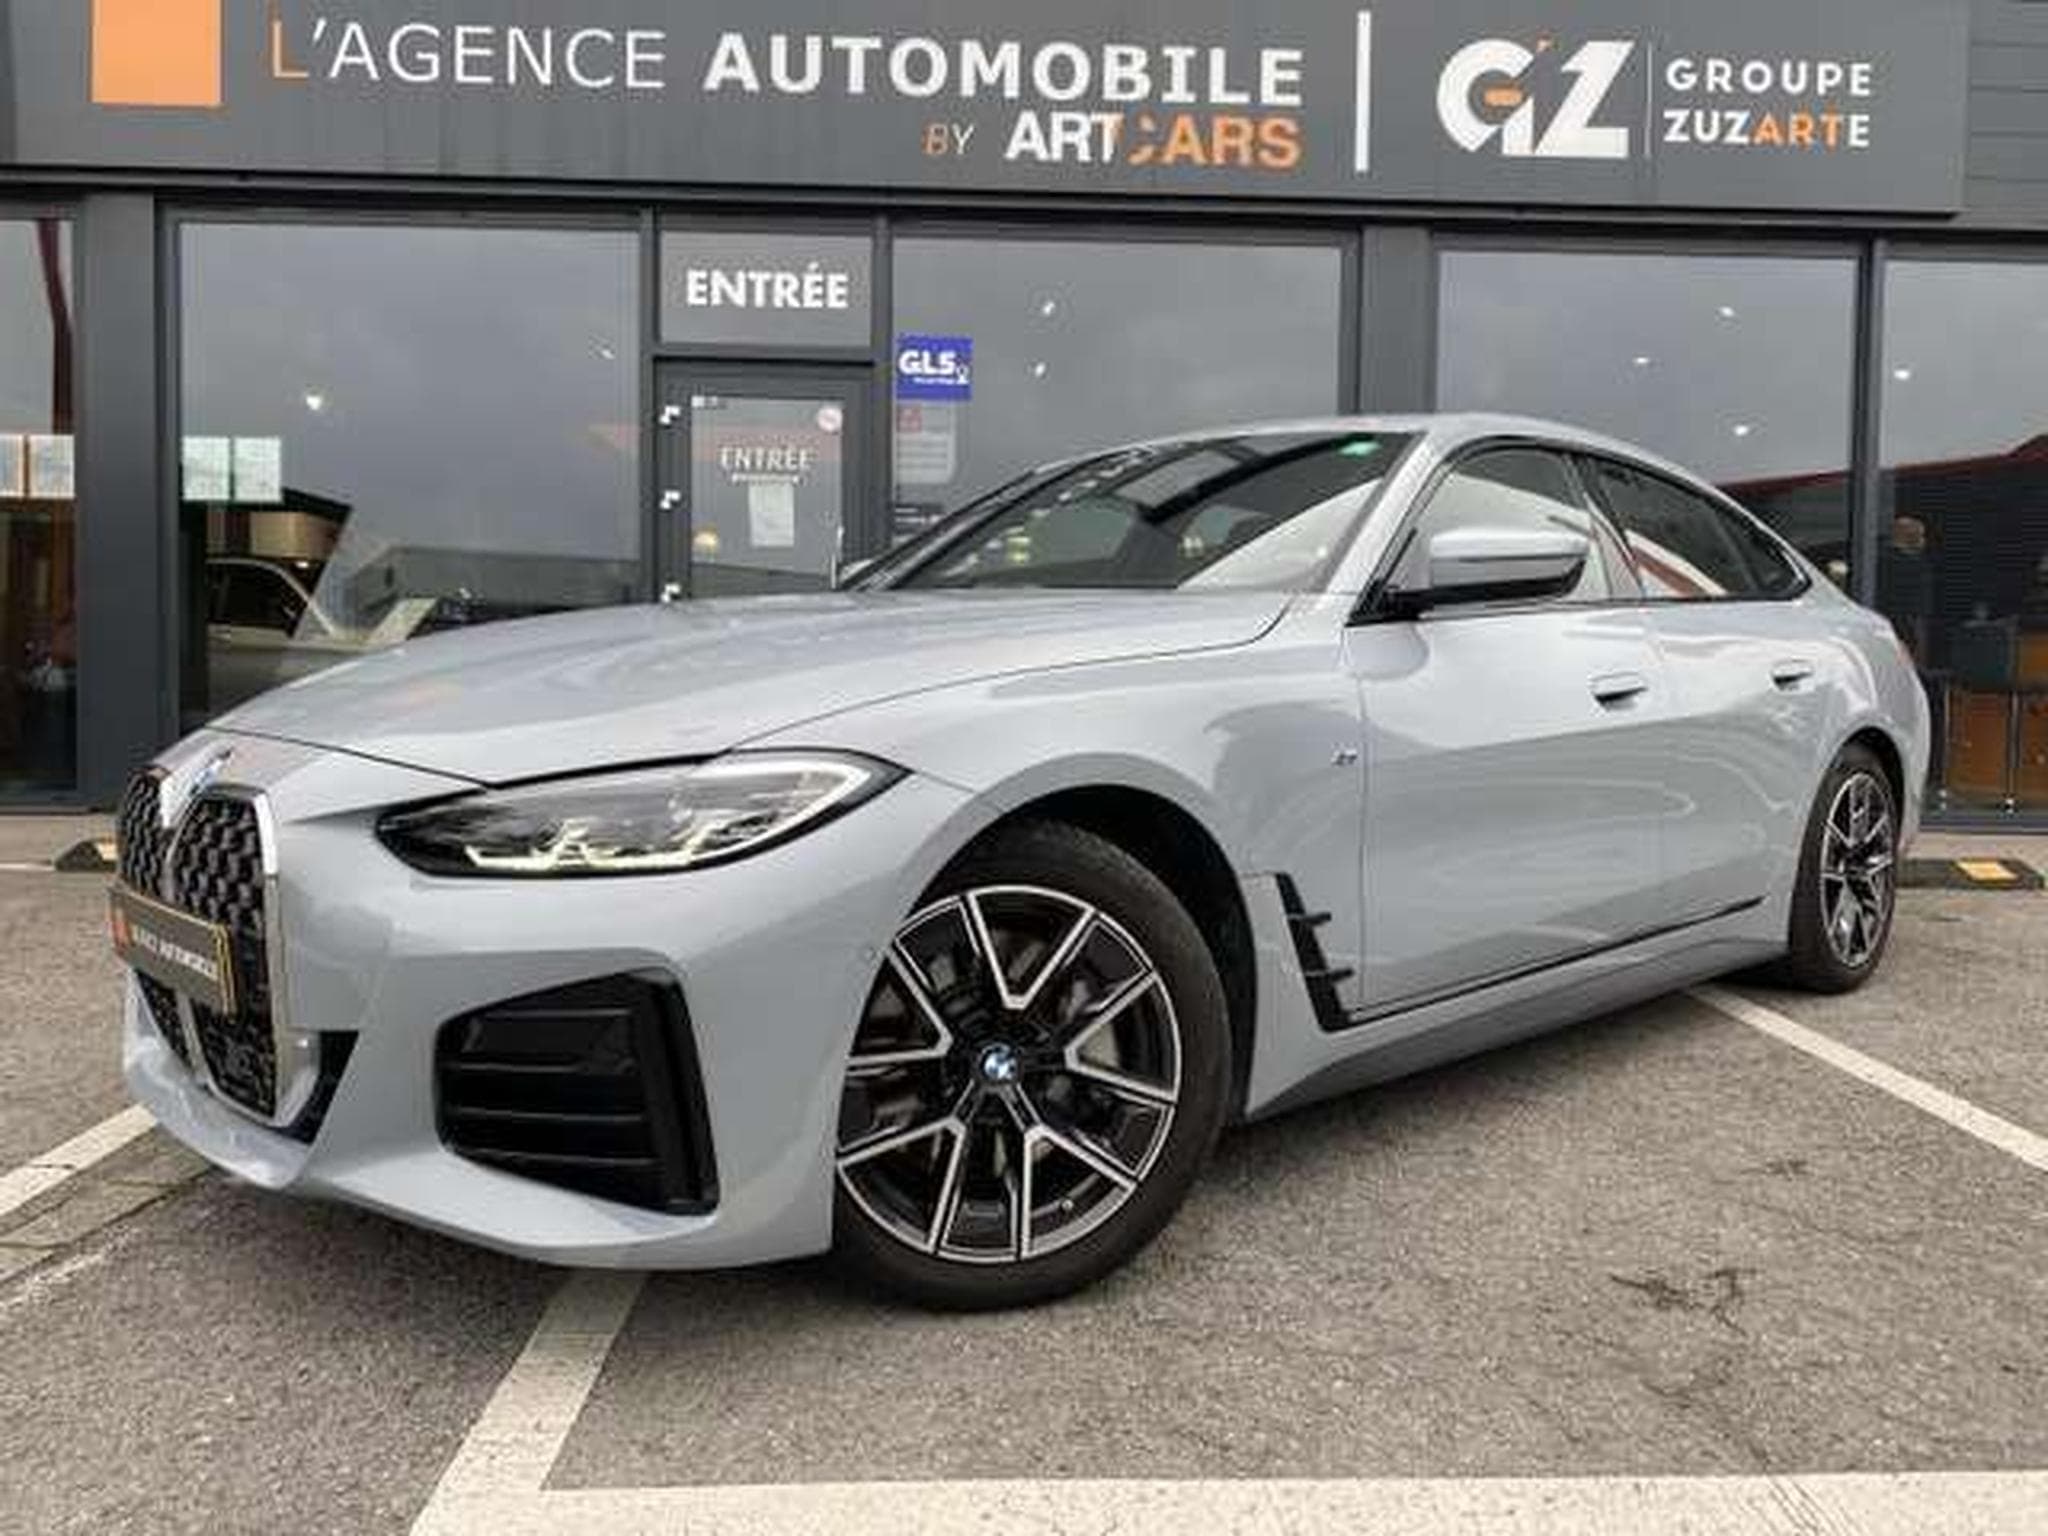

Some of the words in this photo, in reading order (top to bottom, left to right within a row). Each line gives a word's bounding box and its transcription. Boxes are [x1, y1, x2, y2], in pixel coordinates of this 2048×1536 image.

[271, 18, 666, 88] L'AGENCE
[703, 32, 1304, 106] AUTOMOBILE
[1665, 58, 1873, 98] GROUPE
[922, 122, 974, 156] BY
[1663, 108, 1872, 149] ZUZARTE
[685, 262, 849, 310] ENTRÉE
[898, 350, 957, 376] GLS
